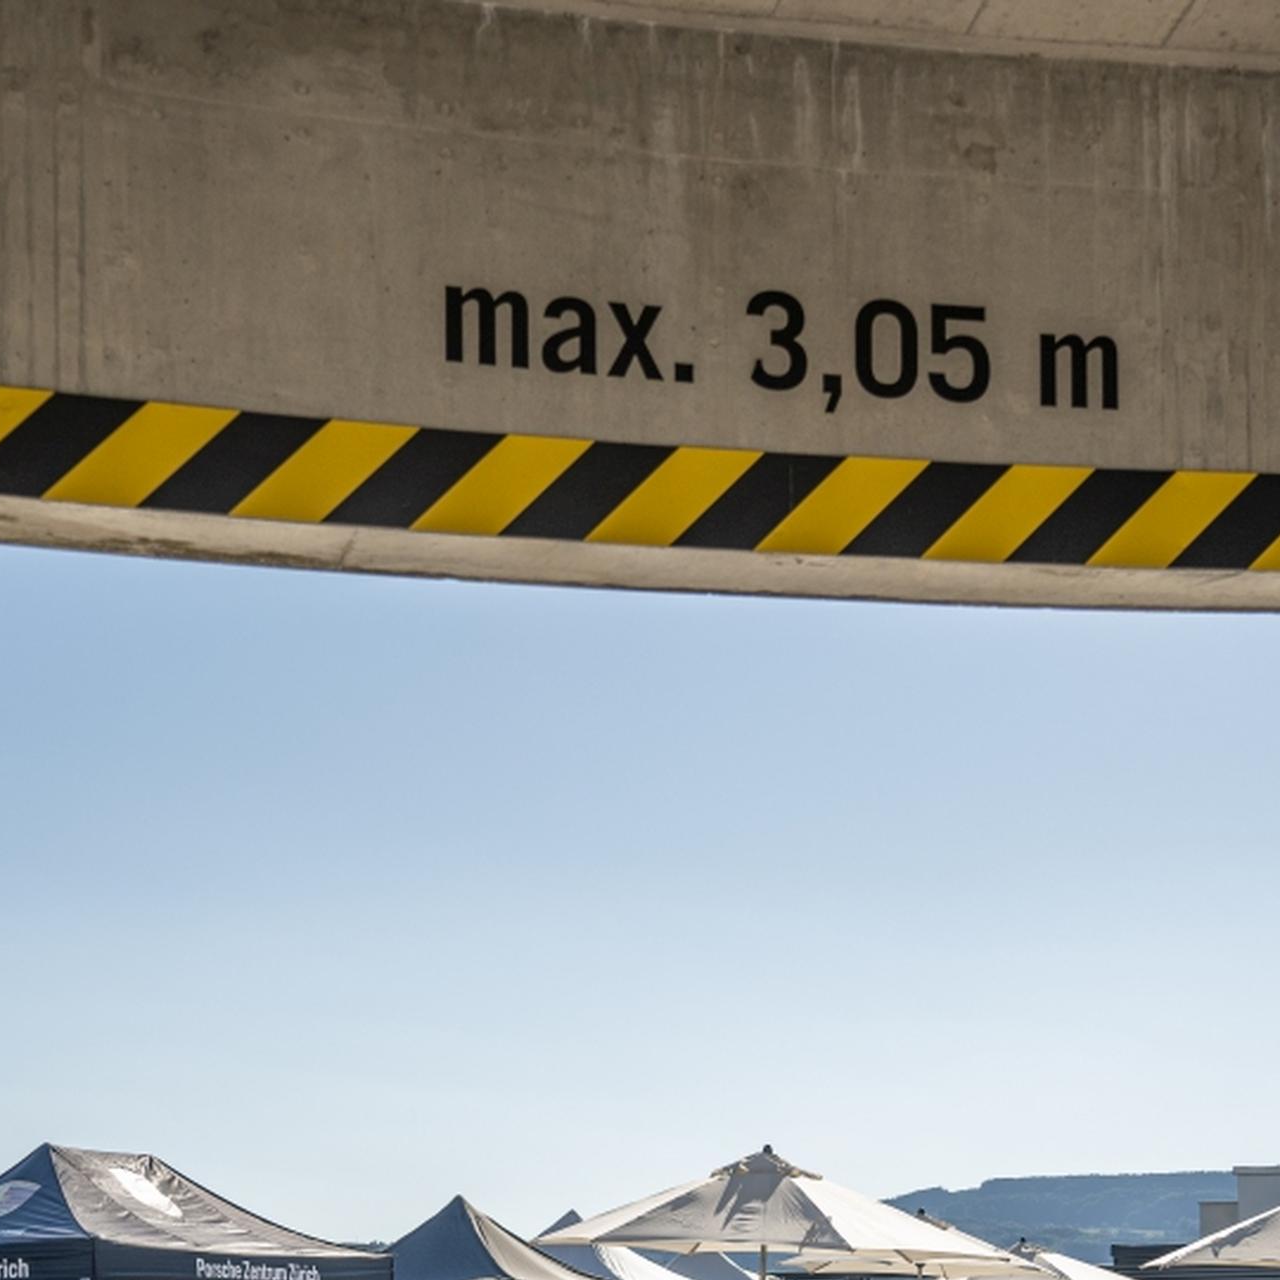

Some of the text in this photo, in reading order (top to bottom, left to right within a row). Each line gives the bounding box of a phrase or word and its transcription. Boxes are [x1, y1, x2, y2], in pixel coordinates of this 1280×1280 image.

[444, 284, 1120, 413] max. 3,05 m
[195, 1257, 242, 1279] Porsche
